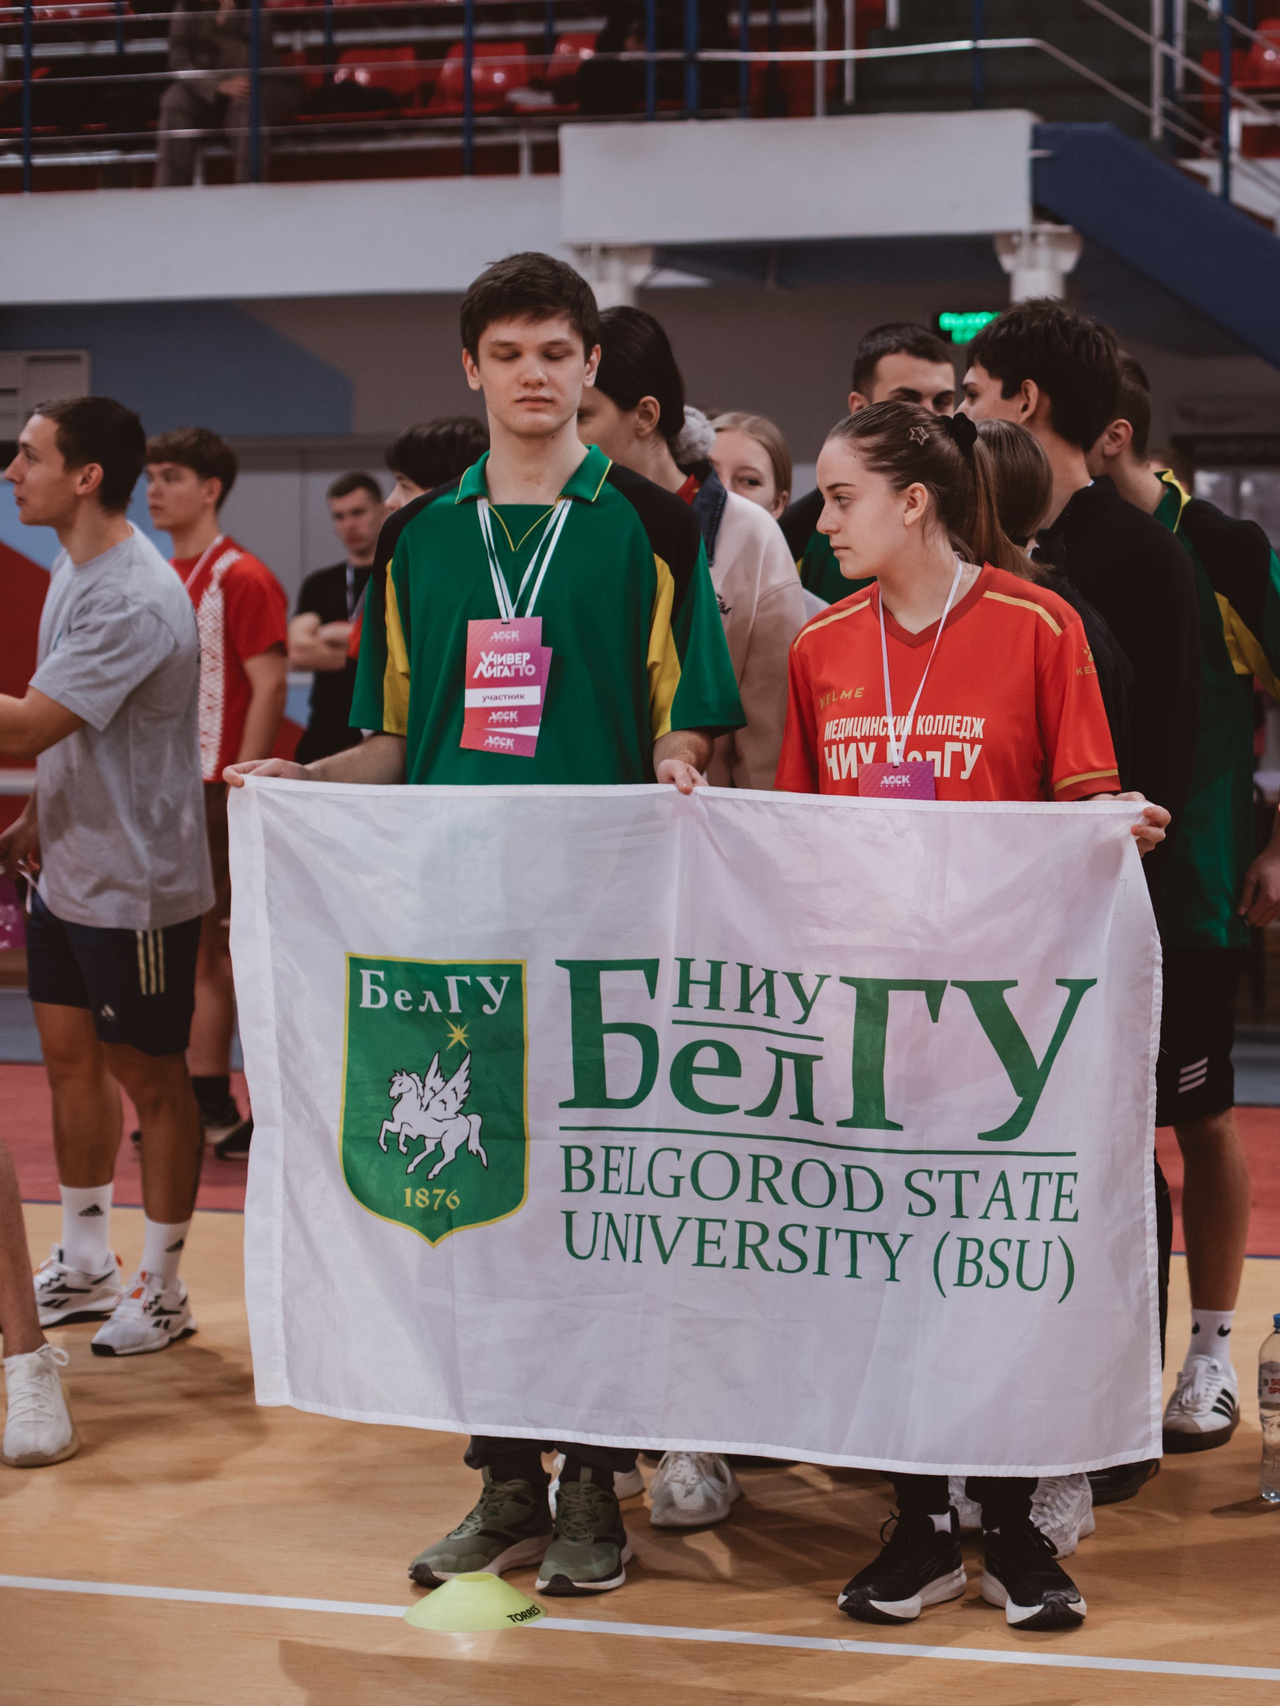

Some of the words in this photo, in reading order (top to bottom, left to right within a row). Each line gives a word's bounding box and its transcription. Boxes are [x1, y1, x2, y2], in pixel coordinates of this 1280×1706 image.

[1076, 666, 1097, 676] KEL
[482, 693, 525, 703] участник
[916, 715, 986, 739] КОЛЛЕДЖ
[359, 969, 510, 1016] БелГУ
[674, 958, 829, 1026] НИУ
[555, 958, 1098, 1142] БелГУ
[403, 1186, 461, 1211] 1876
[560, 1144, 885, 1214] BELGOROD
[908, 1168, 1079, 1224] STATE
[563, 1210, 913, 1284] UNIVERSITY
[932, 1236, 1076, 1304] (BSU)
[506, 1604, 541, 1624] TORRES
